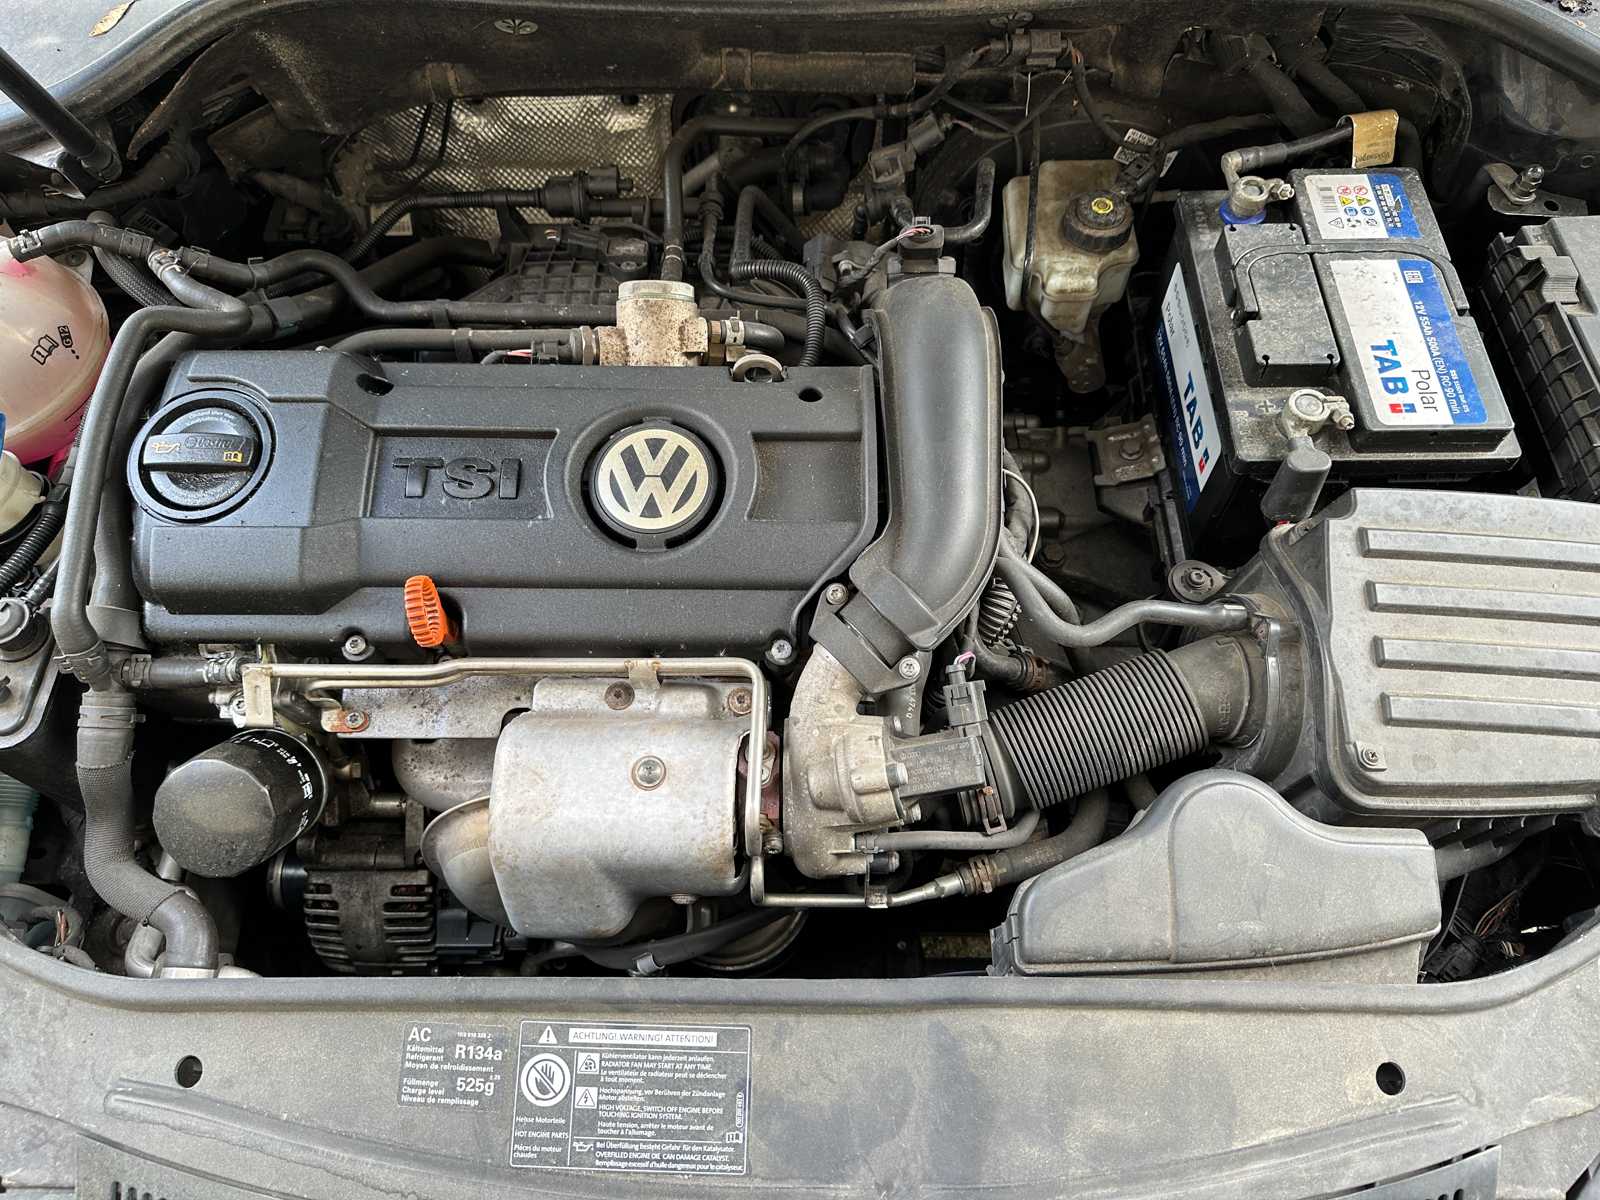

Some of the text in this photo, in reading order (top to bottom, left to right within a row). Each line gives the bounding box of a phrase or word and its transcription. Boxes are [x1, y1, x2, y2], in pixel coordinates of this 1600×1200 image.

[1413, 301, 1461, 414] 12V 55Ah 500A (EN) RC 90 min
[1370, 339, 1410, 395] TAB
[1411, 370, 1438, 412] Polar
[1184, 370, 1204, 450] TAB
[393, 457, 522, 499] TSI
[598, 428, 710, 530] VW
[408, 1026, 432, 1042] AC
[573, 1031, 714, 1043] ACHTUNG! WARNING! ATTENTION!
[406, 1053, 444, 1062] Refrigerant
[455, 1044, 503, 1060] R134a
[405, 1061, 428, 1070] Moyen
[440, 1063, 494, 1072] refroidissement
[658, 1062, 674, 1070] START
[608, 1069, 639, 1077] ventilateur
[648, 1070, 674, 1078] radiateur
[674, 1072, 688, 1080] peut
[403, 1078, 439, 1088] Füllmenge
[456, 1077, 495, 1096] 525g
[402, 1086, 445, 1096] Charge level
[682, 1089, 691, 1097] der
[401, 1095, 479, 1107] Niveau de remplissage
[679, 1106, 701, 1114] ENGINE
[551, 1131, 569, 1139] PARTS
[541, 1145, 562, 1153] moteur
[595, 1151, 629, 1159] OVERFILLED
[676, 1153, 701, 1161] DAMAGE
